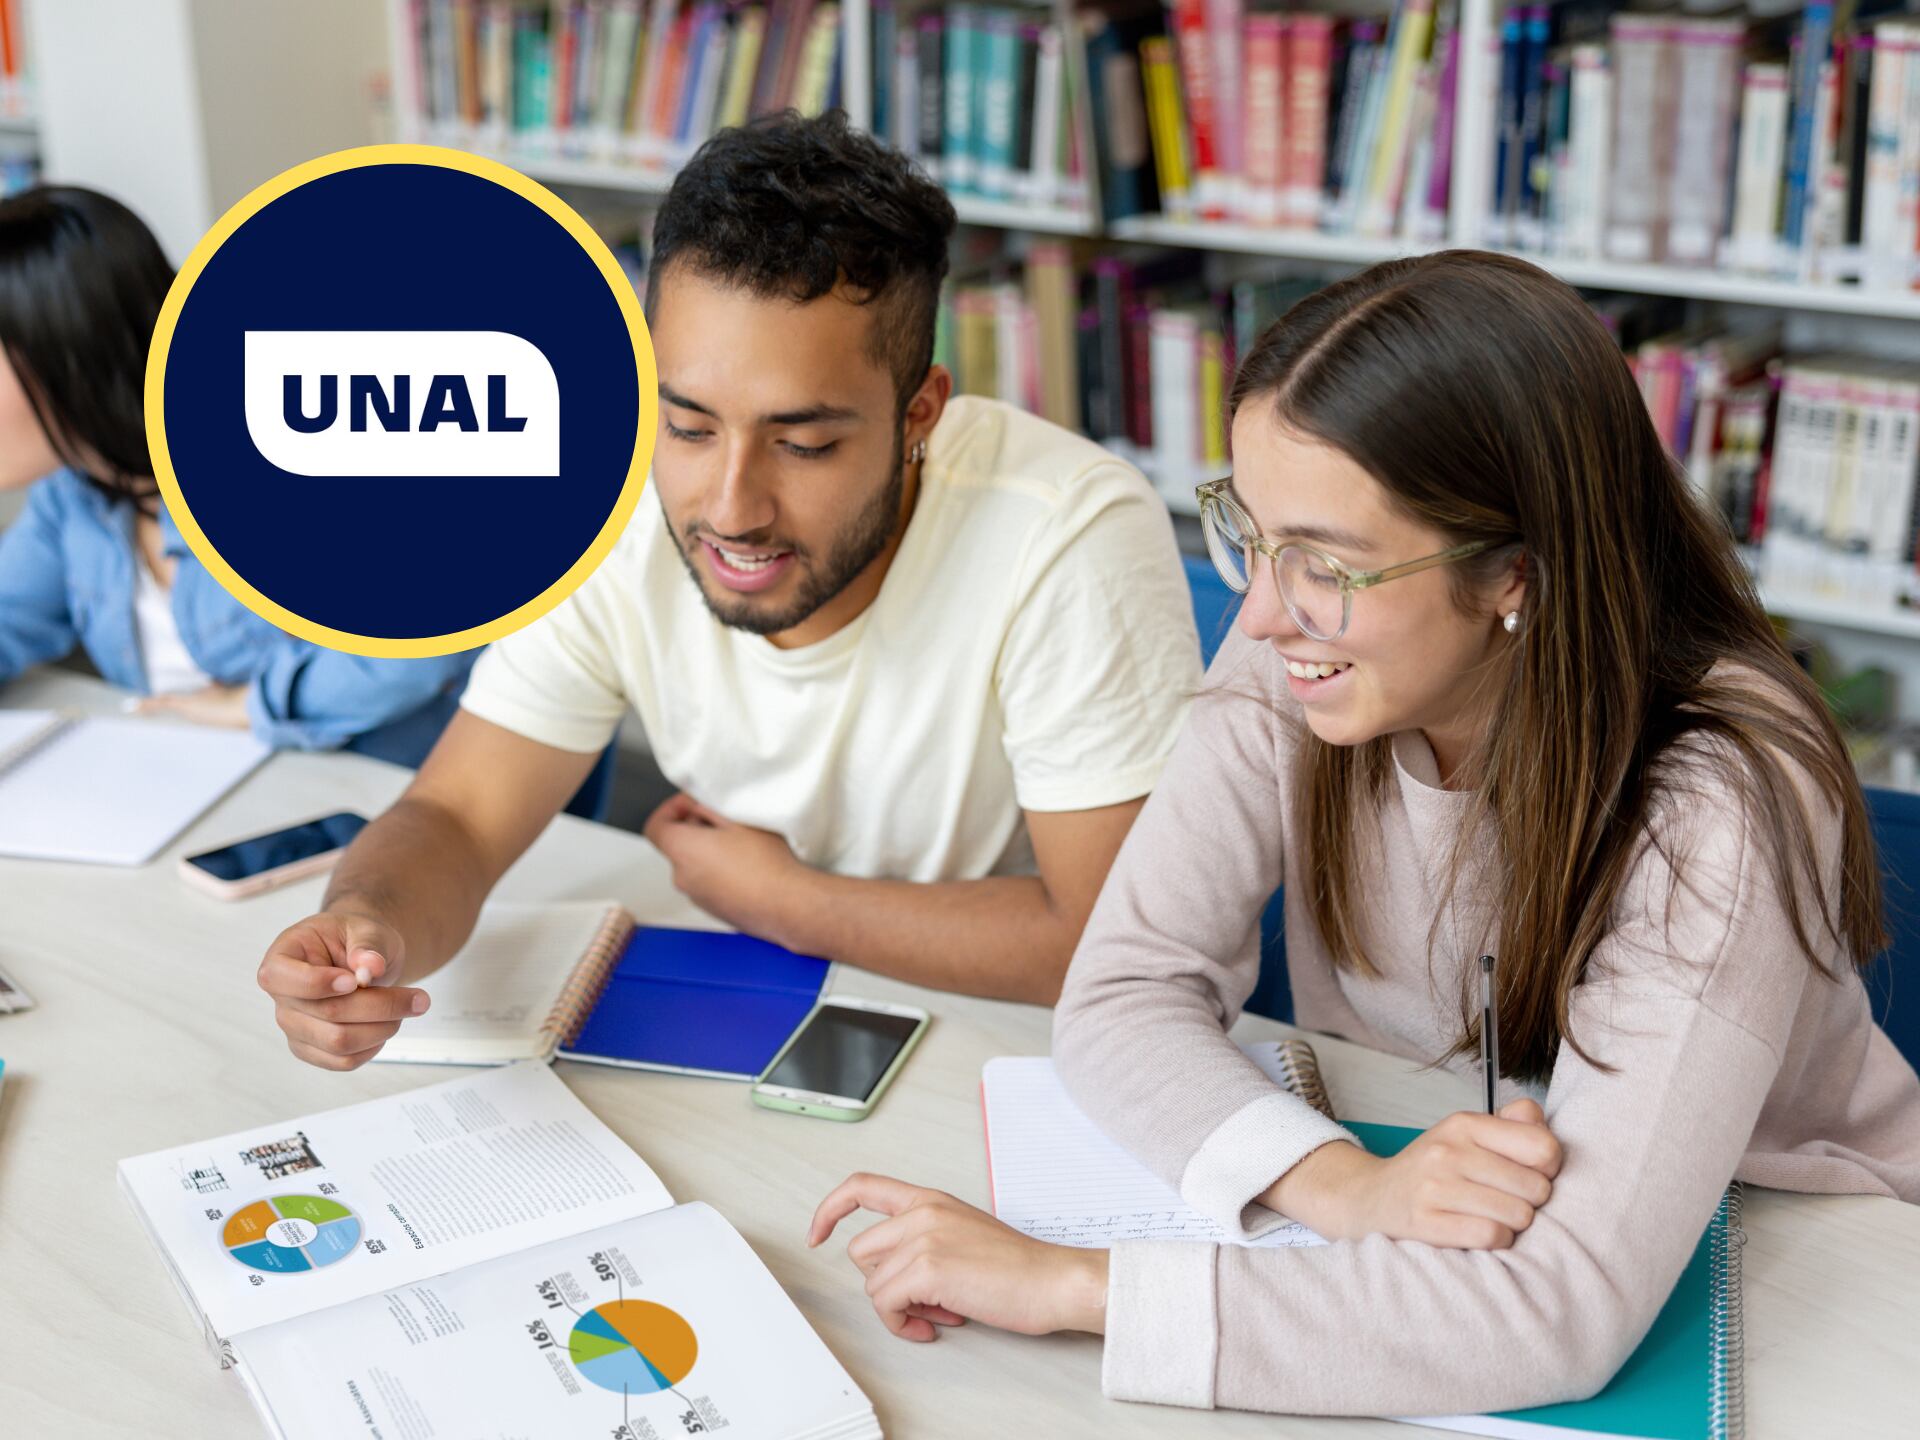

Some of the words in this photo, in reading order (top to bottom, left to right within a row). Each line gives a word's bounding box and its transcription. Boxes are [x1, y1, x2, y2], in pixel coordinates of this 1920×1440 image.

[364, 1239, 382, 1254] 85%
[402, 1223, 424, 1250] Espacios
[587, 1251, 617, 1282] 50%
[535, 1280, 564, 1310] 14%
[525, 1320, 555, 1350] 16%
[346, 1380, 375, 1424] Associates
[678, 1410, 704, 1435] 5%
